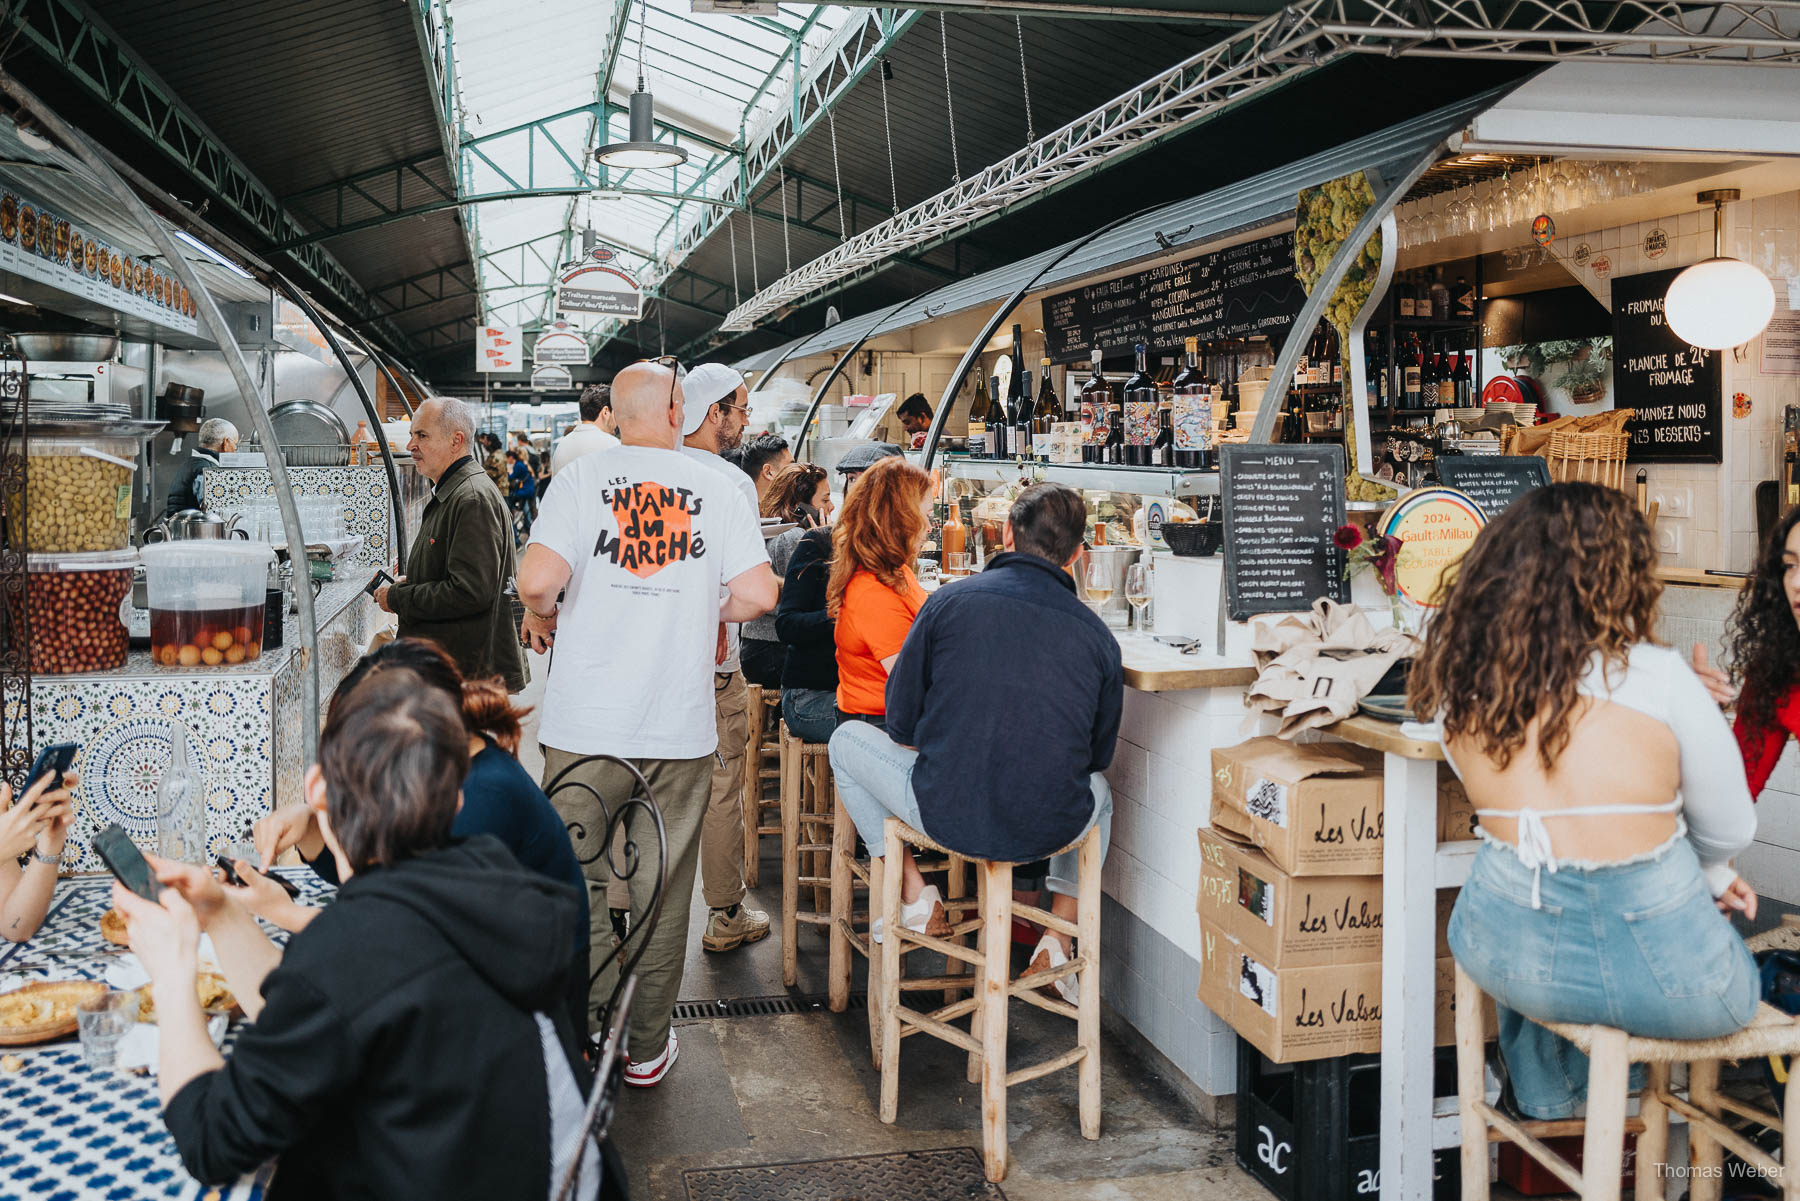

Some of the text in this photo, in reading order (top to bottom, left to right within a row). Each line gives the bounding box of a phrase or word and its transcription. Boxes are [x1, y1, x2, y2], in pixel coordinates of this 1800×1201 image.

[1152, 262, 1183, 280] SARDINES
[1228, 260, 1251, 273] TERRINE
[1110, 279, 1123, 294] FILET
[1230, 272, 1258, 288] ESCARGOTS
[1168, 289, 1190, 304] COCHON
[1258, 315, 1290, 328] GORGONZOLA
[1650, 315, 1661, 326] DU
[1629, 354, 1668, 372] PLANCHE
[1675, 352, 1686, 367] DE
[1649, 369, 1694, 386] FROMAGE
[1632, 404, 1706, 421] MANDEZ NOUS
[1634, 426, 1701, 444] LES DESSERTS
[1265, 457, 1294, 465] MENU
[608, 477, 628, 486] LES
[602, 483, 703, 516] ENFANTS
[625, 509, 664, 540] du
[1424, 514, 1450, 523] 2024
[1315, 803, 1383, 843] Les Val
[1299, 894, 1327, 933] Les
[1296, 988, 1324, 1027] Les
[1258, 1125, 1291, 1174] ac
